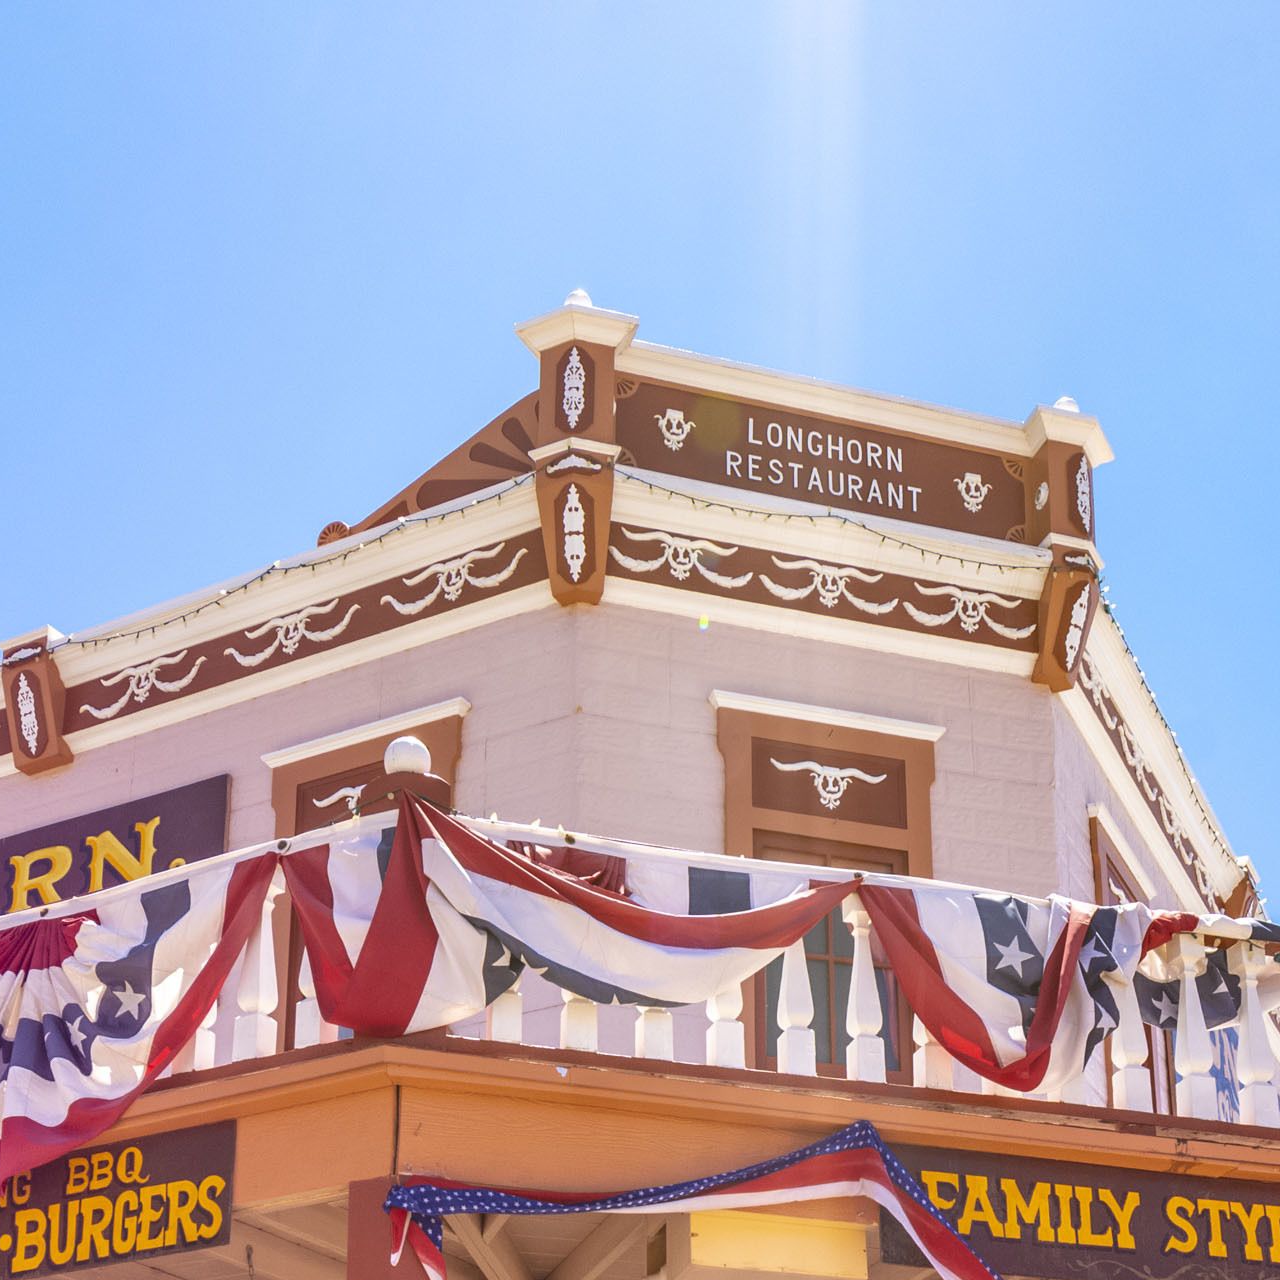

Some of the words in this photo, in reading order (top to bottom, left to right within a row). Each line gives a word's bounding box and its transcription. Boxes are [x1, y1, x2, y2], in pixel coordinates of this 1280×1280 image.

[748, 417, 904, 473] LONGHORN
[725, 450, 923, 513] RESTAURANT
[66, 1147, 150, 1195] BBQ
[10, 1175, 226, 1274] BURGERS
[921, 1170, 1140, 1250] FAMILY
